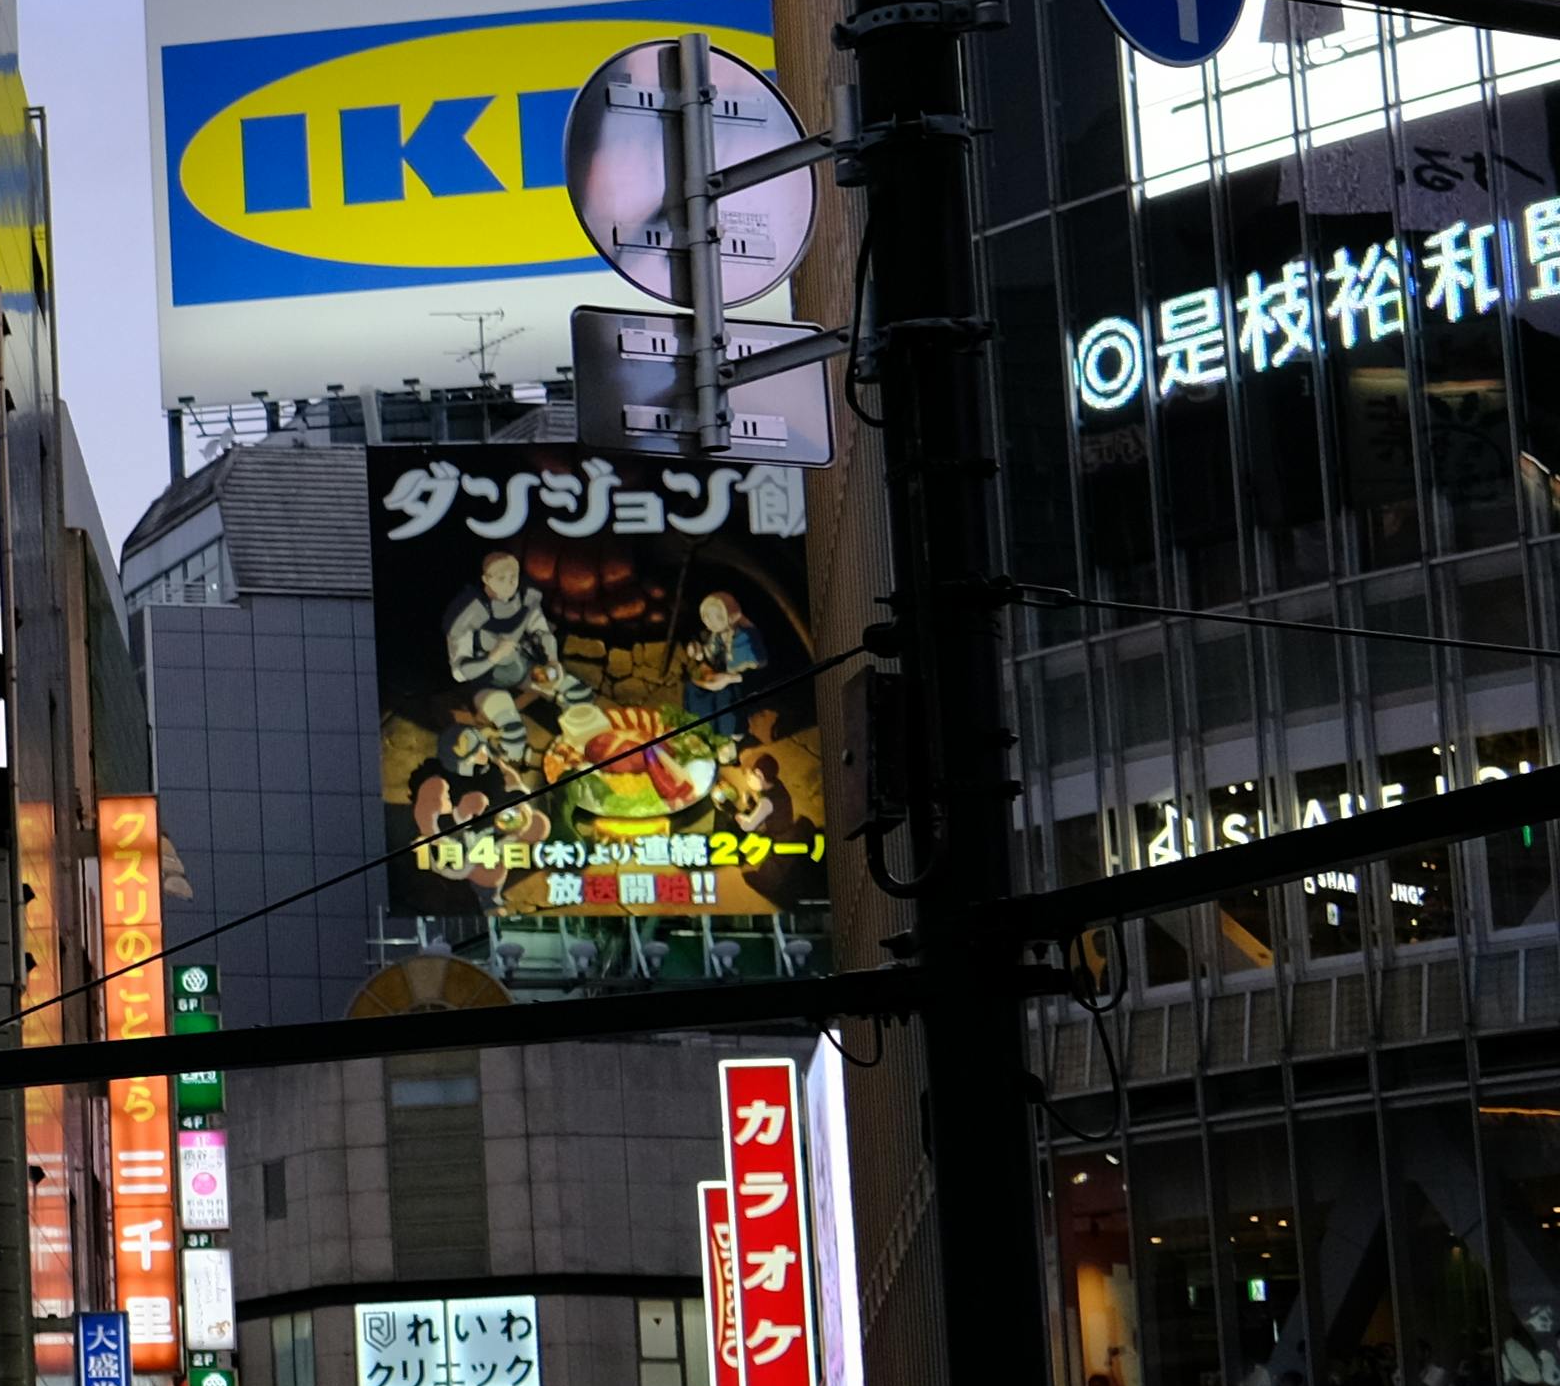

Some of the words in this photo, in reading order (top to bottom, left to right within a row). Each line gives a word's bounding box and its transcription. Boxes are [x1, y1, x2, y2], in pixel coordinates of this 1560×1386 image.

[117, 1150, 173, 1344] 三千里
[407, 1309, 533, 1346] れいわ
[733, 1099, 803, 1366] カラオケ
